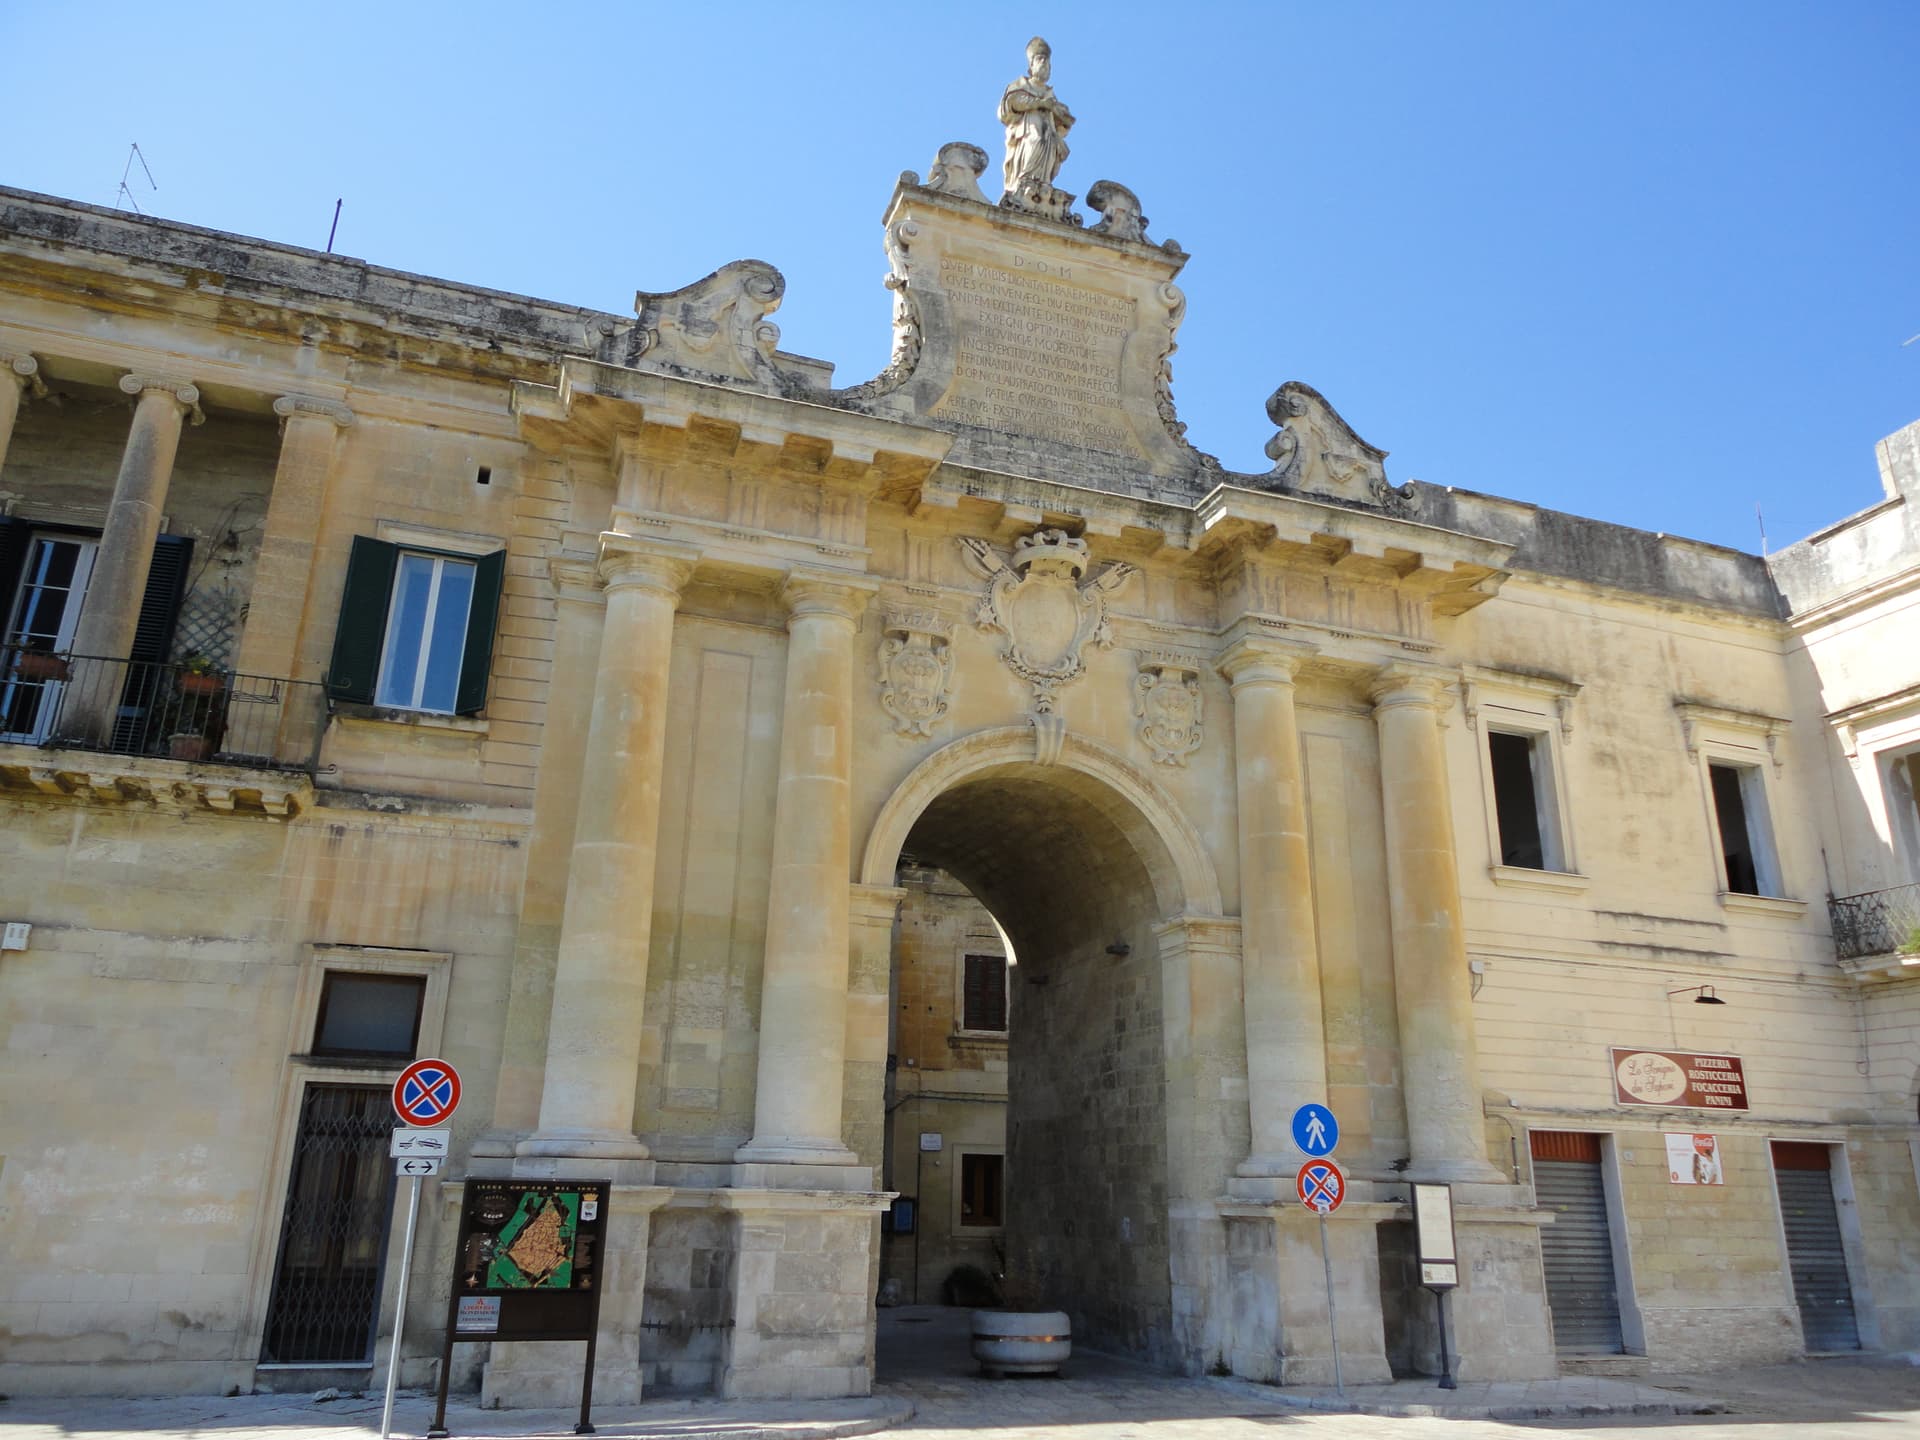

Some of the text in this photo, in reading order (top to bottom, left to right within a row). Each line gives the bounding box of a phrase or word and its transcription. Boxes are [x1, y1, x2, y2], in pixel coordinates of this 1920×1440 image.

[946, 274, 976, 290] CIVES
[946, 288, 992, 308] TANDEM
[1694, 1058, 1731, 1069] PIZZERIA
[1688, 1070, 1741, 1082] ROSTICCERIA
[1691, 1082, 1742, 1094] FOCACCERIA
[1705, 1095, 1733, 1106] PANINI
